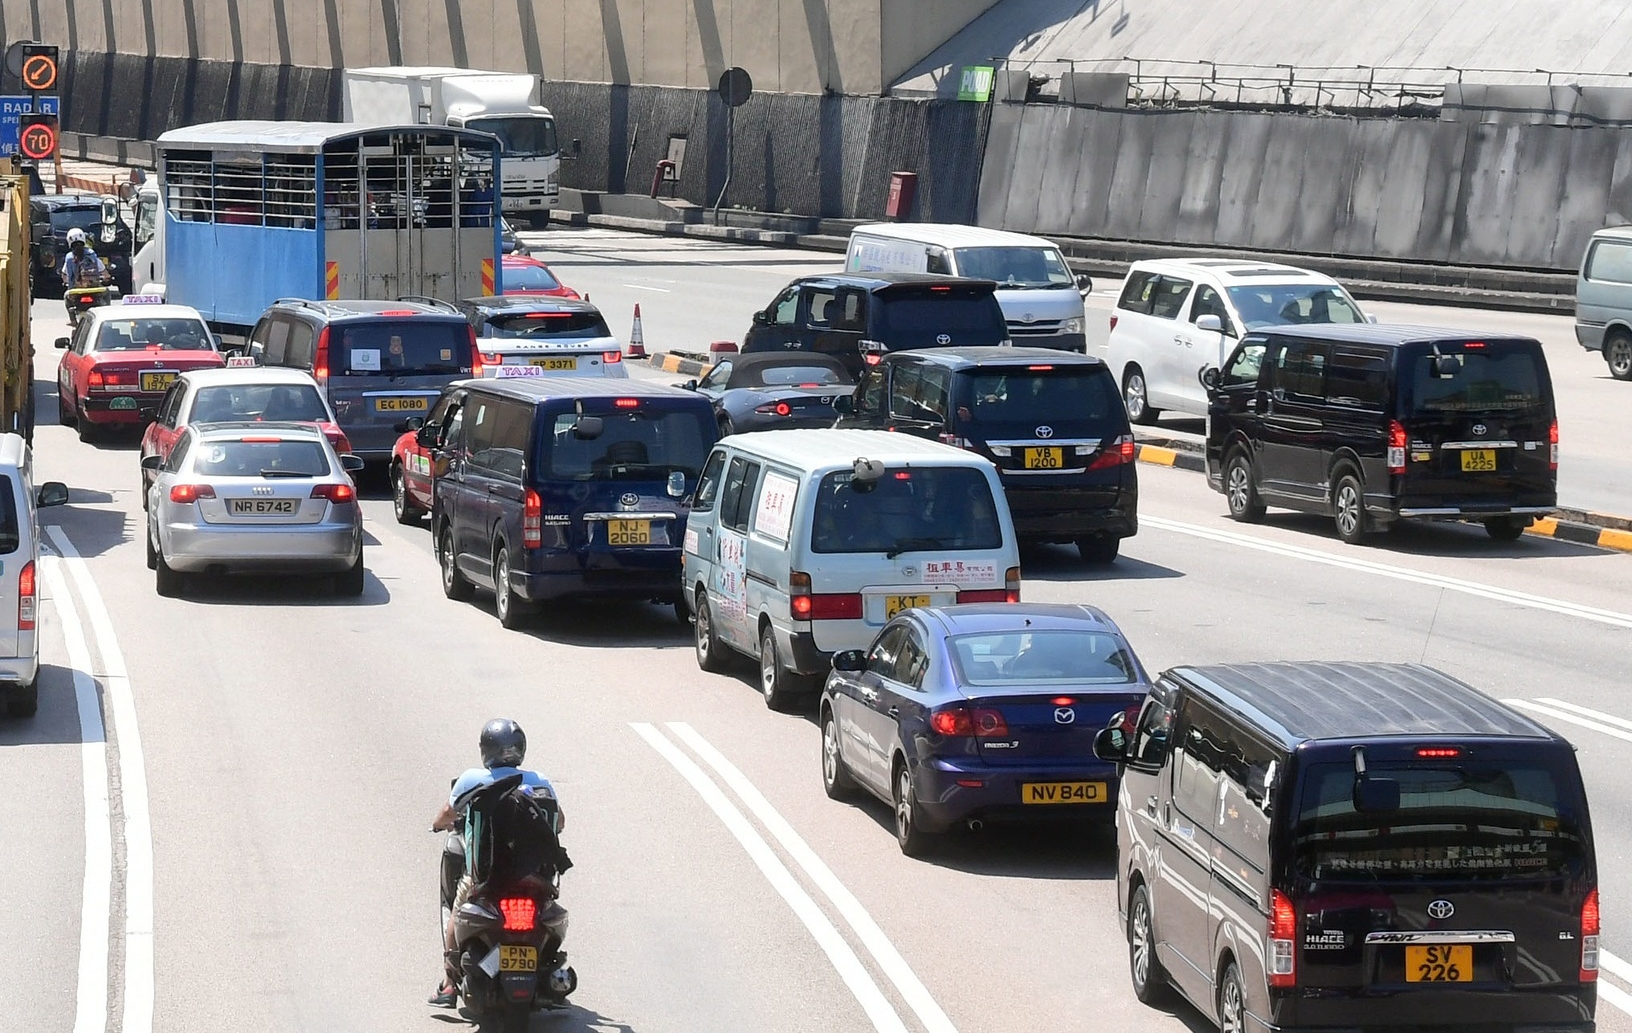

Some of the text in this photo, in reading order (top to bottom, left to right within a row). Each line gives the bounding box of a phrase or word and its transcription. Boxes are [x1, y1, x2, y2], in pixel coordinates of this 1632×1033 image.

[28, 134, 48, 150] 70
[126, 295, 160, 304] TAXI
[230, 358, 254, 367] TAXI
[549, 358, 574, 369] 3371
[502, 366, 541, 376] TAXI
[152, 374, 166, 383] SX
[380, 399, 423, 410] EG 1080
[1036, 448, 1051, 457] VB
[1470, 451, 1486, 460] UA
[1030, 457, 1057, 467] 1200
[1464, 460, 1494, 471] 4225
[234, 501, 293, 513] NR 6742
[619, 521, 639, 532] NJ
[610, 532, 648, 545] 2060
[926, 561, 965, 573] 租車易
[898, 595, 918, 607] KT
[1032, 784, 1098, 801] NV 840
[1305, 935, 1345, 943] HIACE
[509, 947, 528, 958] PN
[1425, 946, 1452, 963] SV
[501, 958, 536, 970] 9790
[1418, 964, 1460, 982] 226
